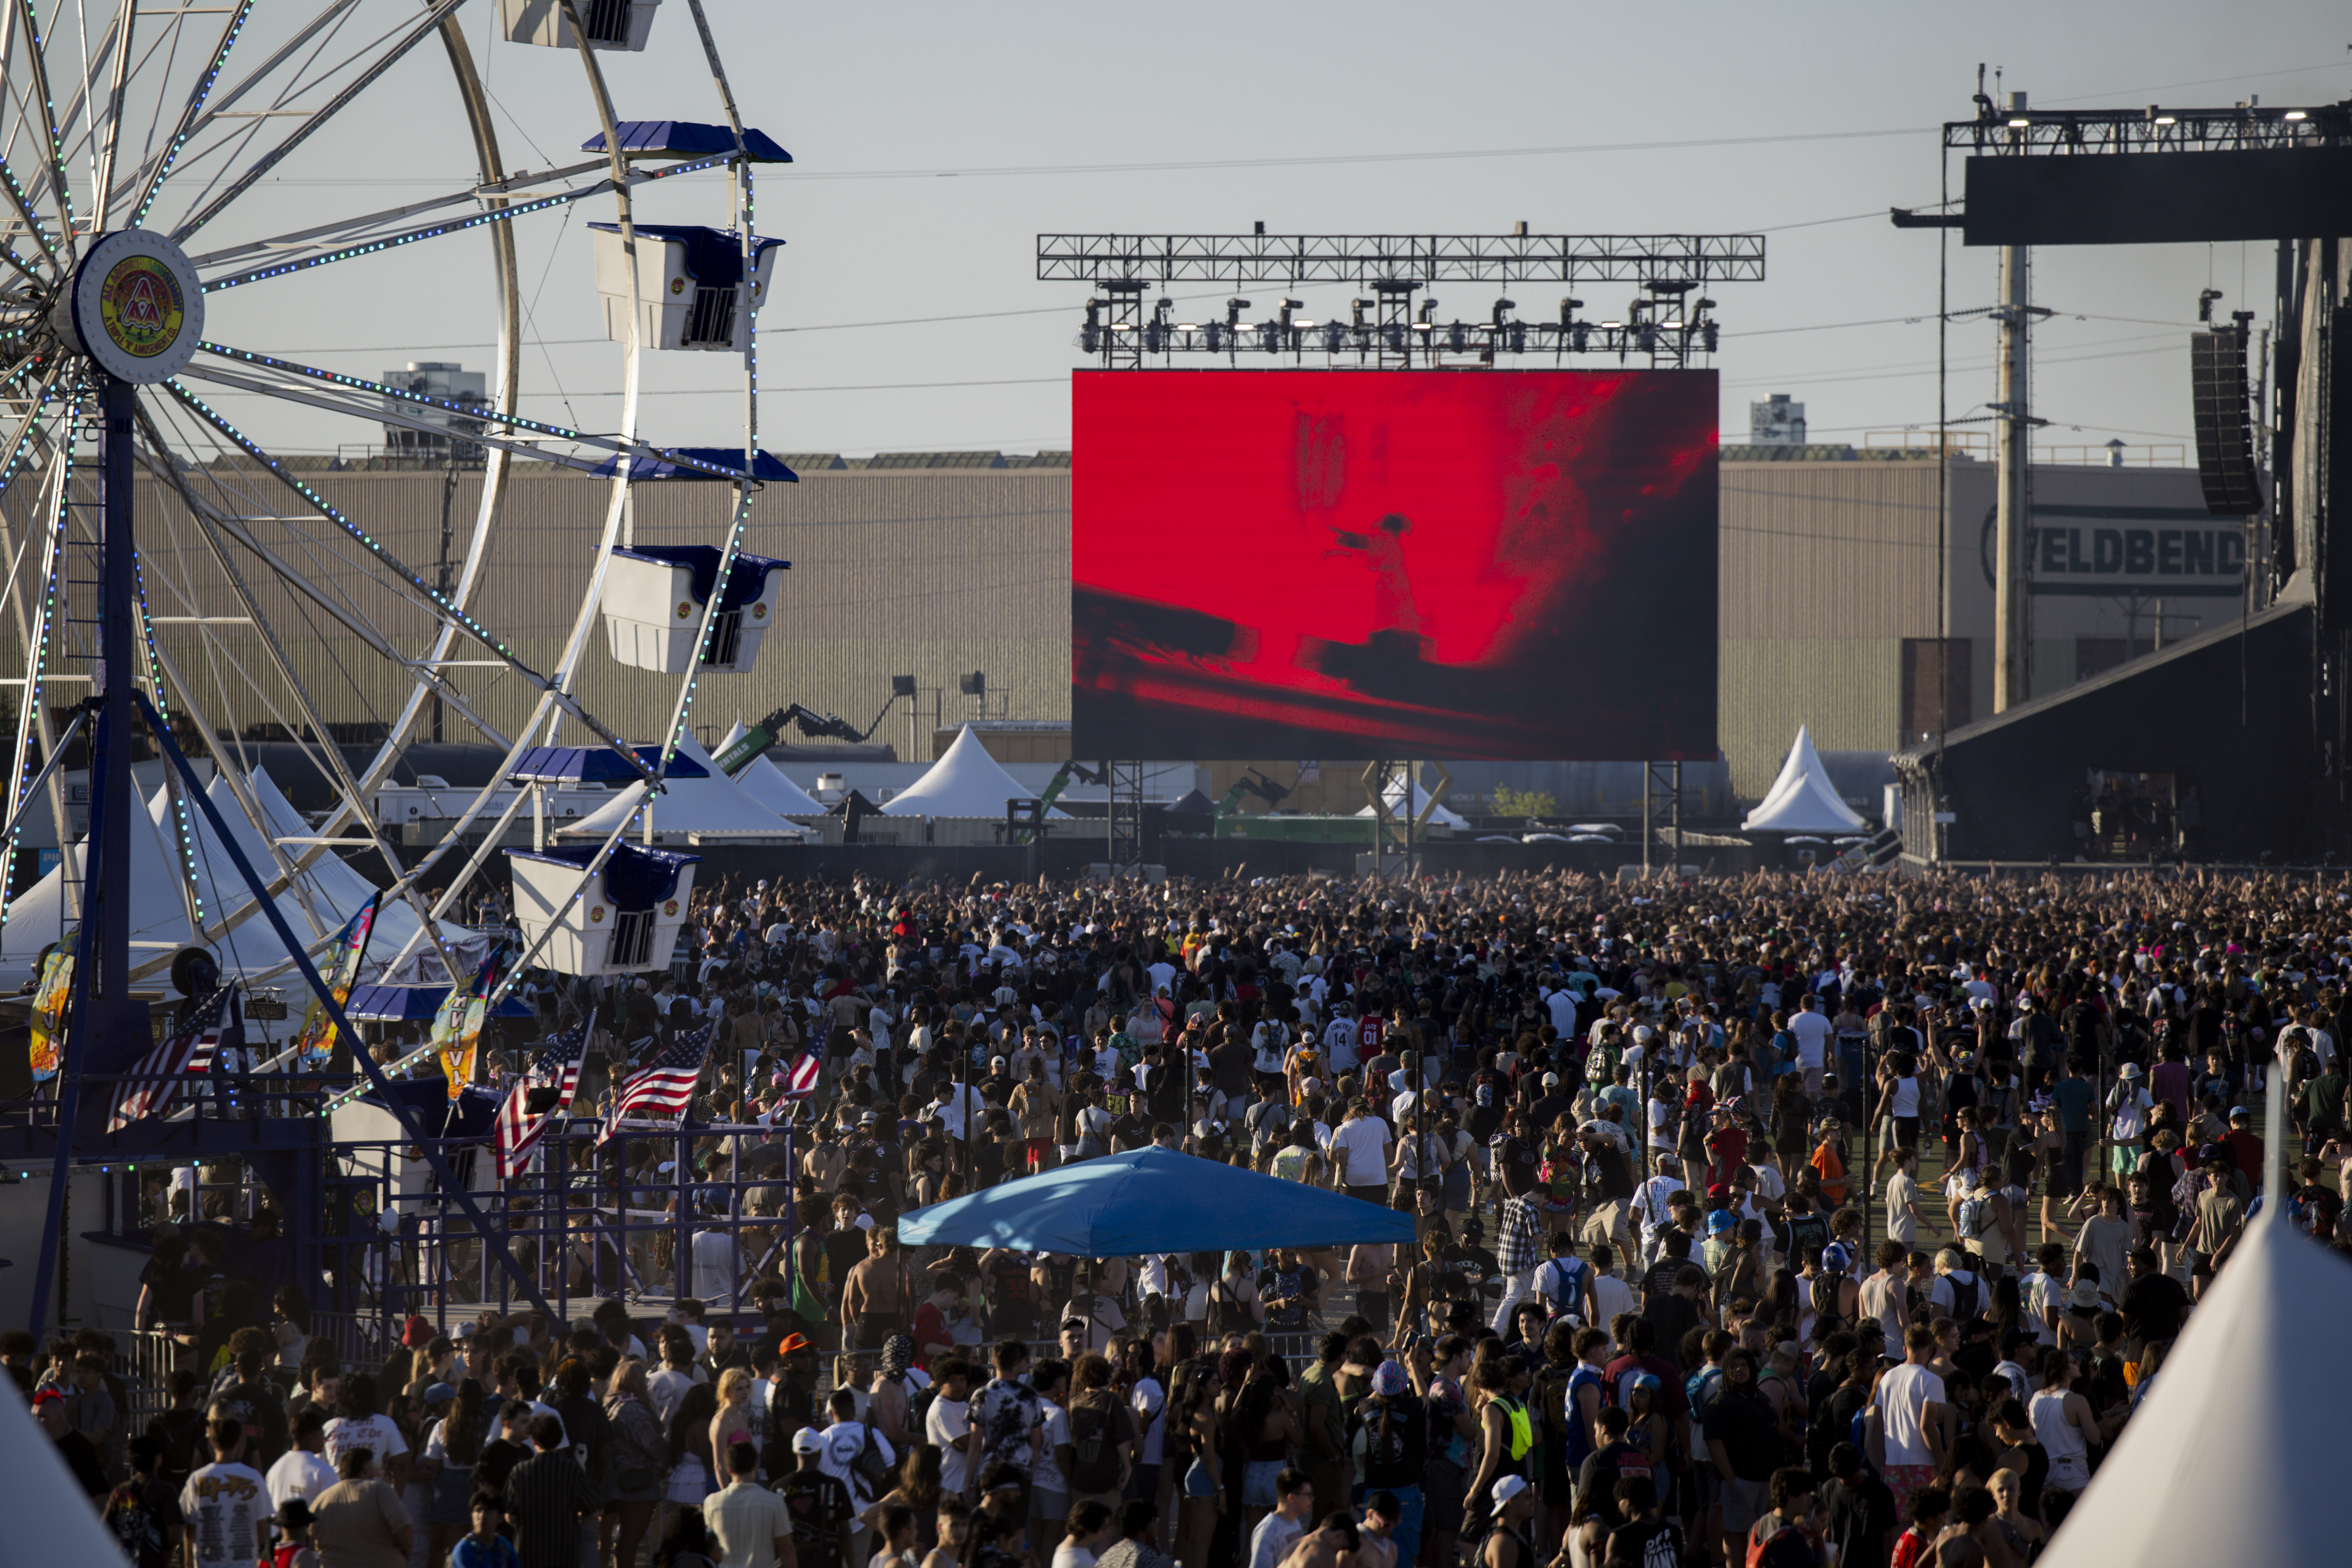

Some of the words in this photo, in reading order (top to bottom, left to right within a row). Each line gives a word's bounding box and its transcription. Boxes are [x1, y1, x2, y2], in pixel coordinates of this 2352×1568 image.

[103, 283, 115, 303] ALL
[111, 258, 144, 281] AROUND
[146, 259, 183, 314] AMUSEMENT
[106, 320, 125, 346] TRIPLE
[133, 333, 169, 355] AMUSEMENT
[2031, 527, 2245, 575] ELDBEND
[716, 741, 751, 769] ENTALS
[1330, 1022, 1352, 1032] KONERKO
[1334, 1032, 1346, 1046] 14
[1363, 1030, 1377, 1045] 01
[1006, 1279, 1028, 1298] 35
[1646, 1528, 1672, 1550] OFF
[1647, 1541, 1676, 1555] WALL
